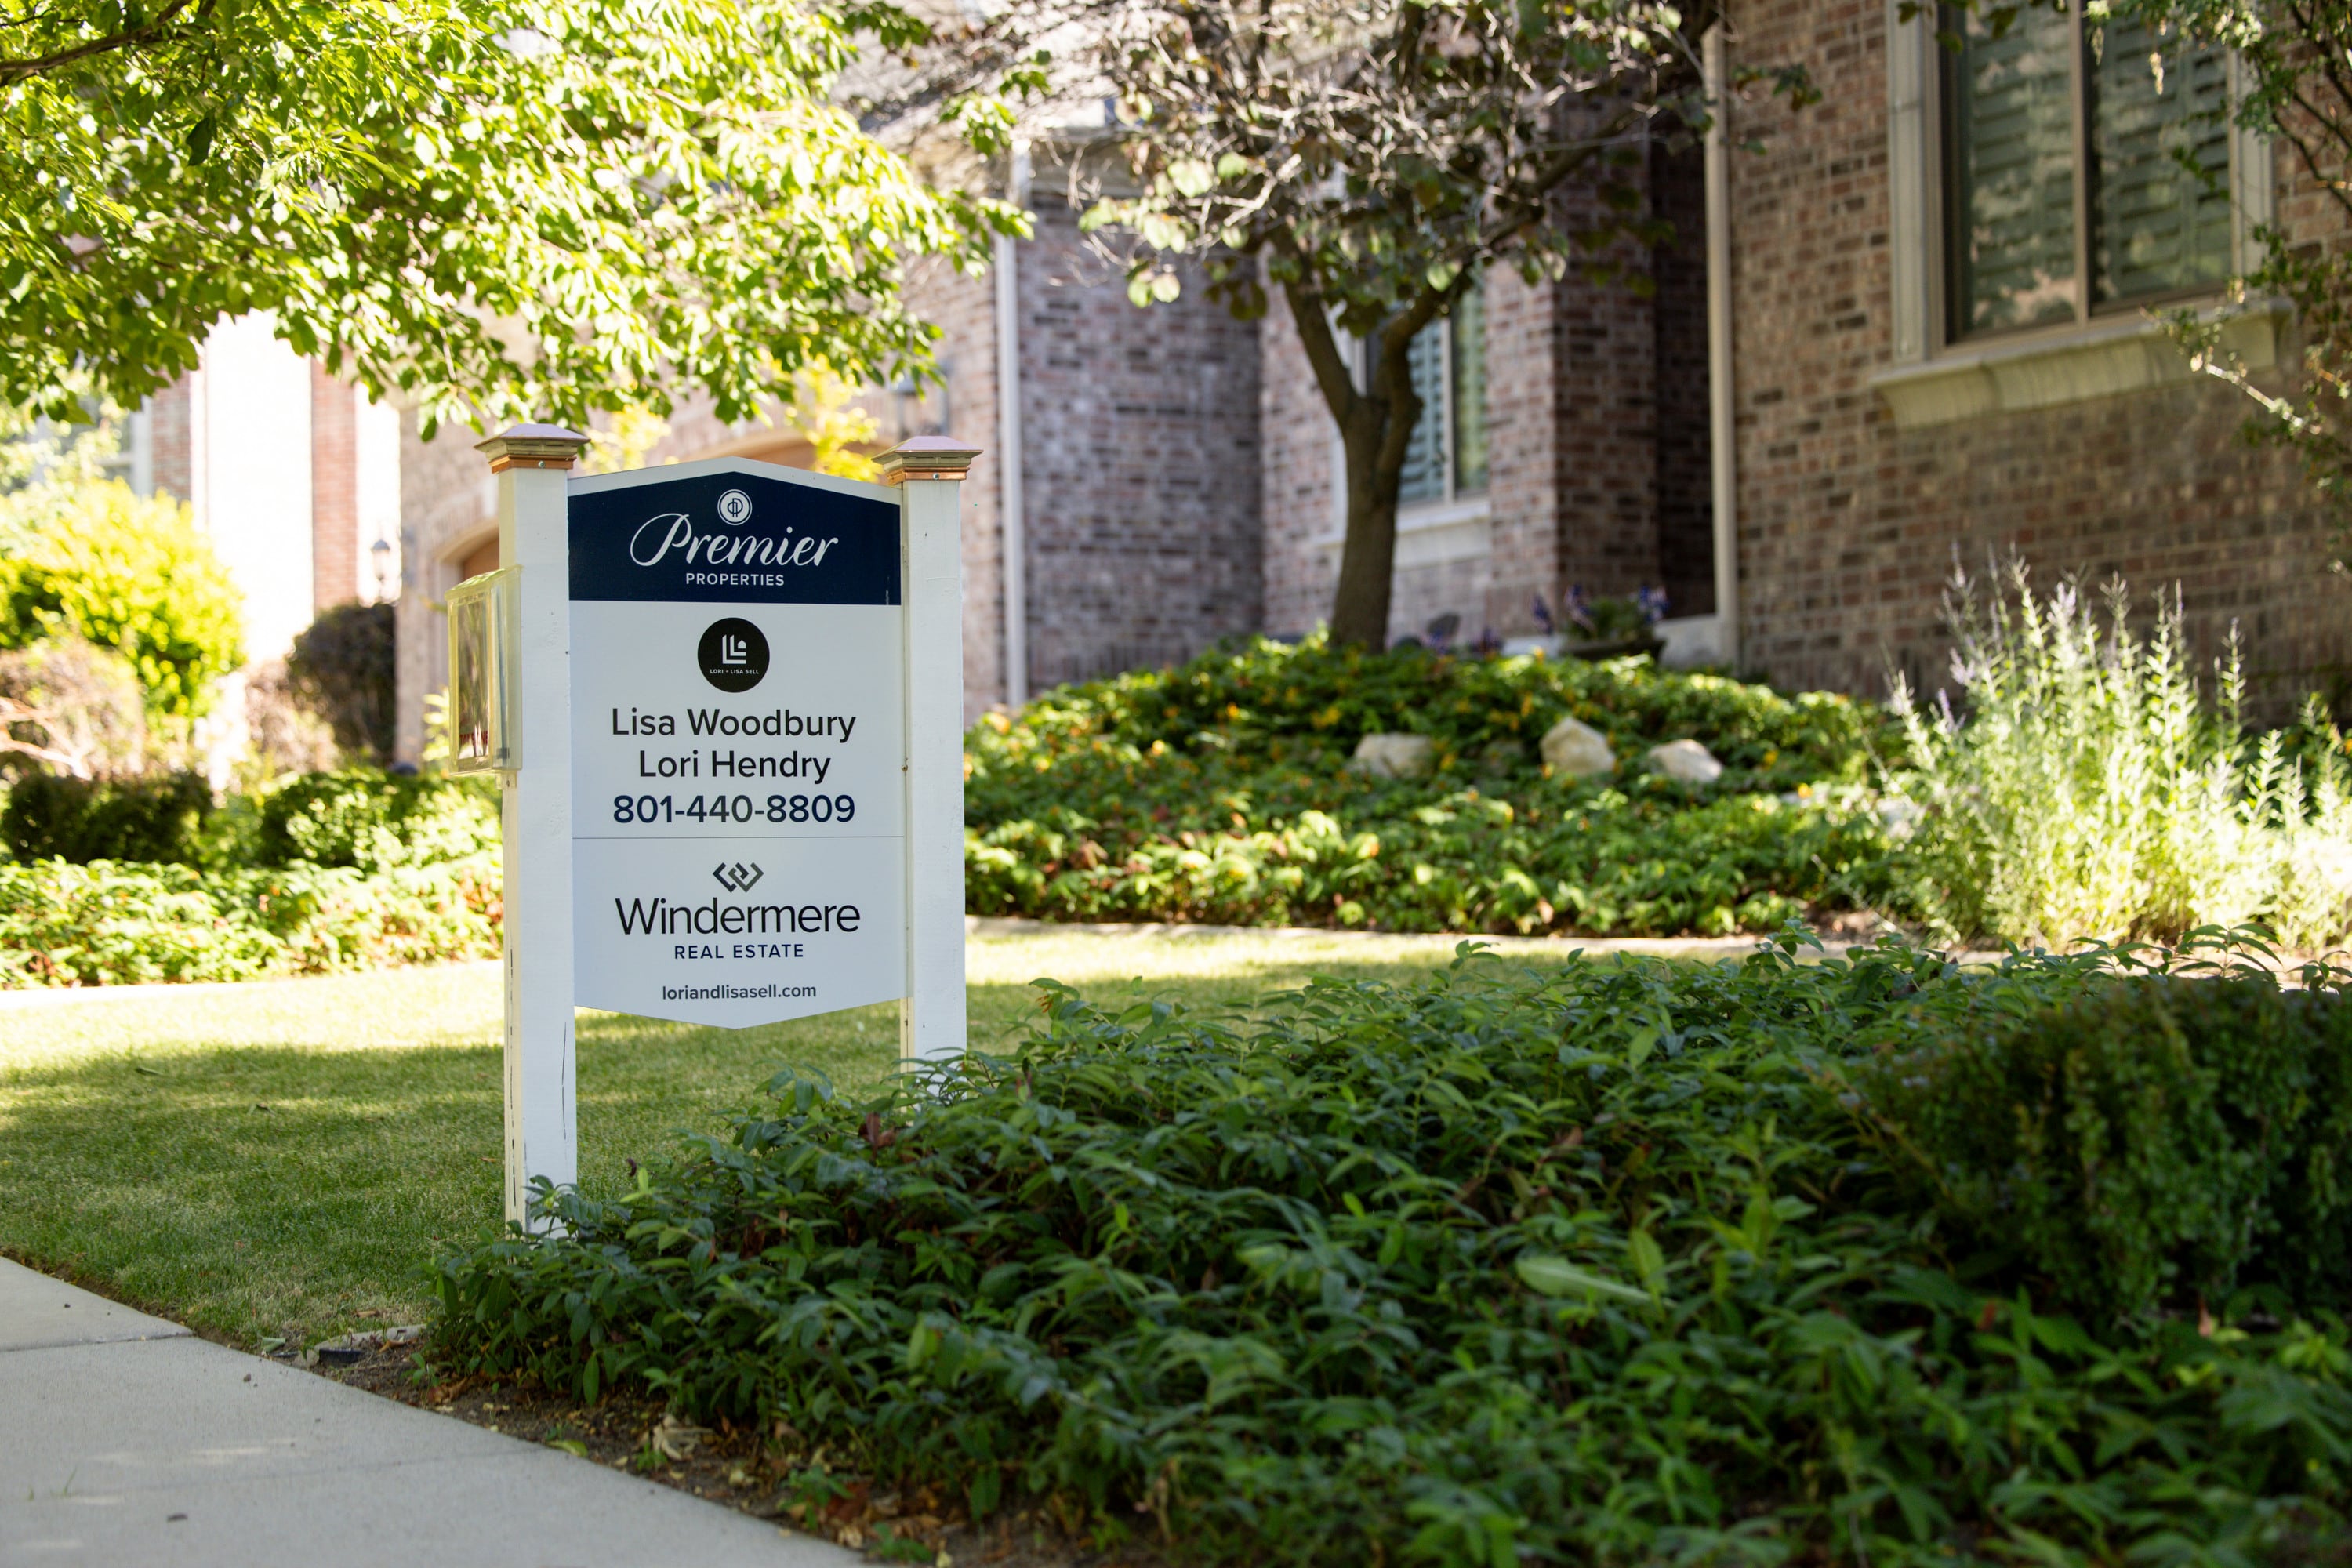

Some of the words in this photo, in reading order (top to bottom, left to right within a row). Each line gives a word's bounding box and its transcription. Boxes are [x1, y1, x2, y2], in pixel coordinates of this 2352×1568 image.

[630, 513, 839, 567] Premier
[686, 572, 785, 587] PROPERTIES
[612, 707, 676, 735] Lisa
[687, 708, 857, 743] Woodbury
[639, 749, 699, 778] Lori
[711, 750, 831, 785] Hendry
[613, 794, 855, 823] 801-440-8809
[615, 897, 861, 935] Windermere
[674, 945, 724, 960] REAL
[733, 943, 804, 959] ESTATE
[662, 984, 817, 1000] loriandlisasell.com
